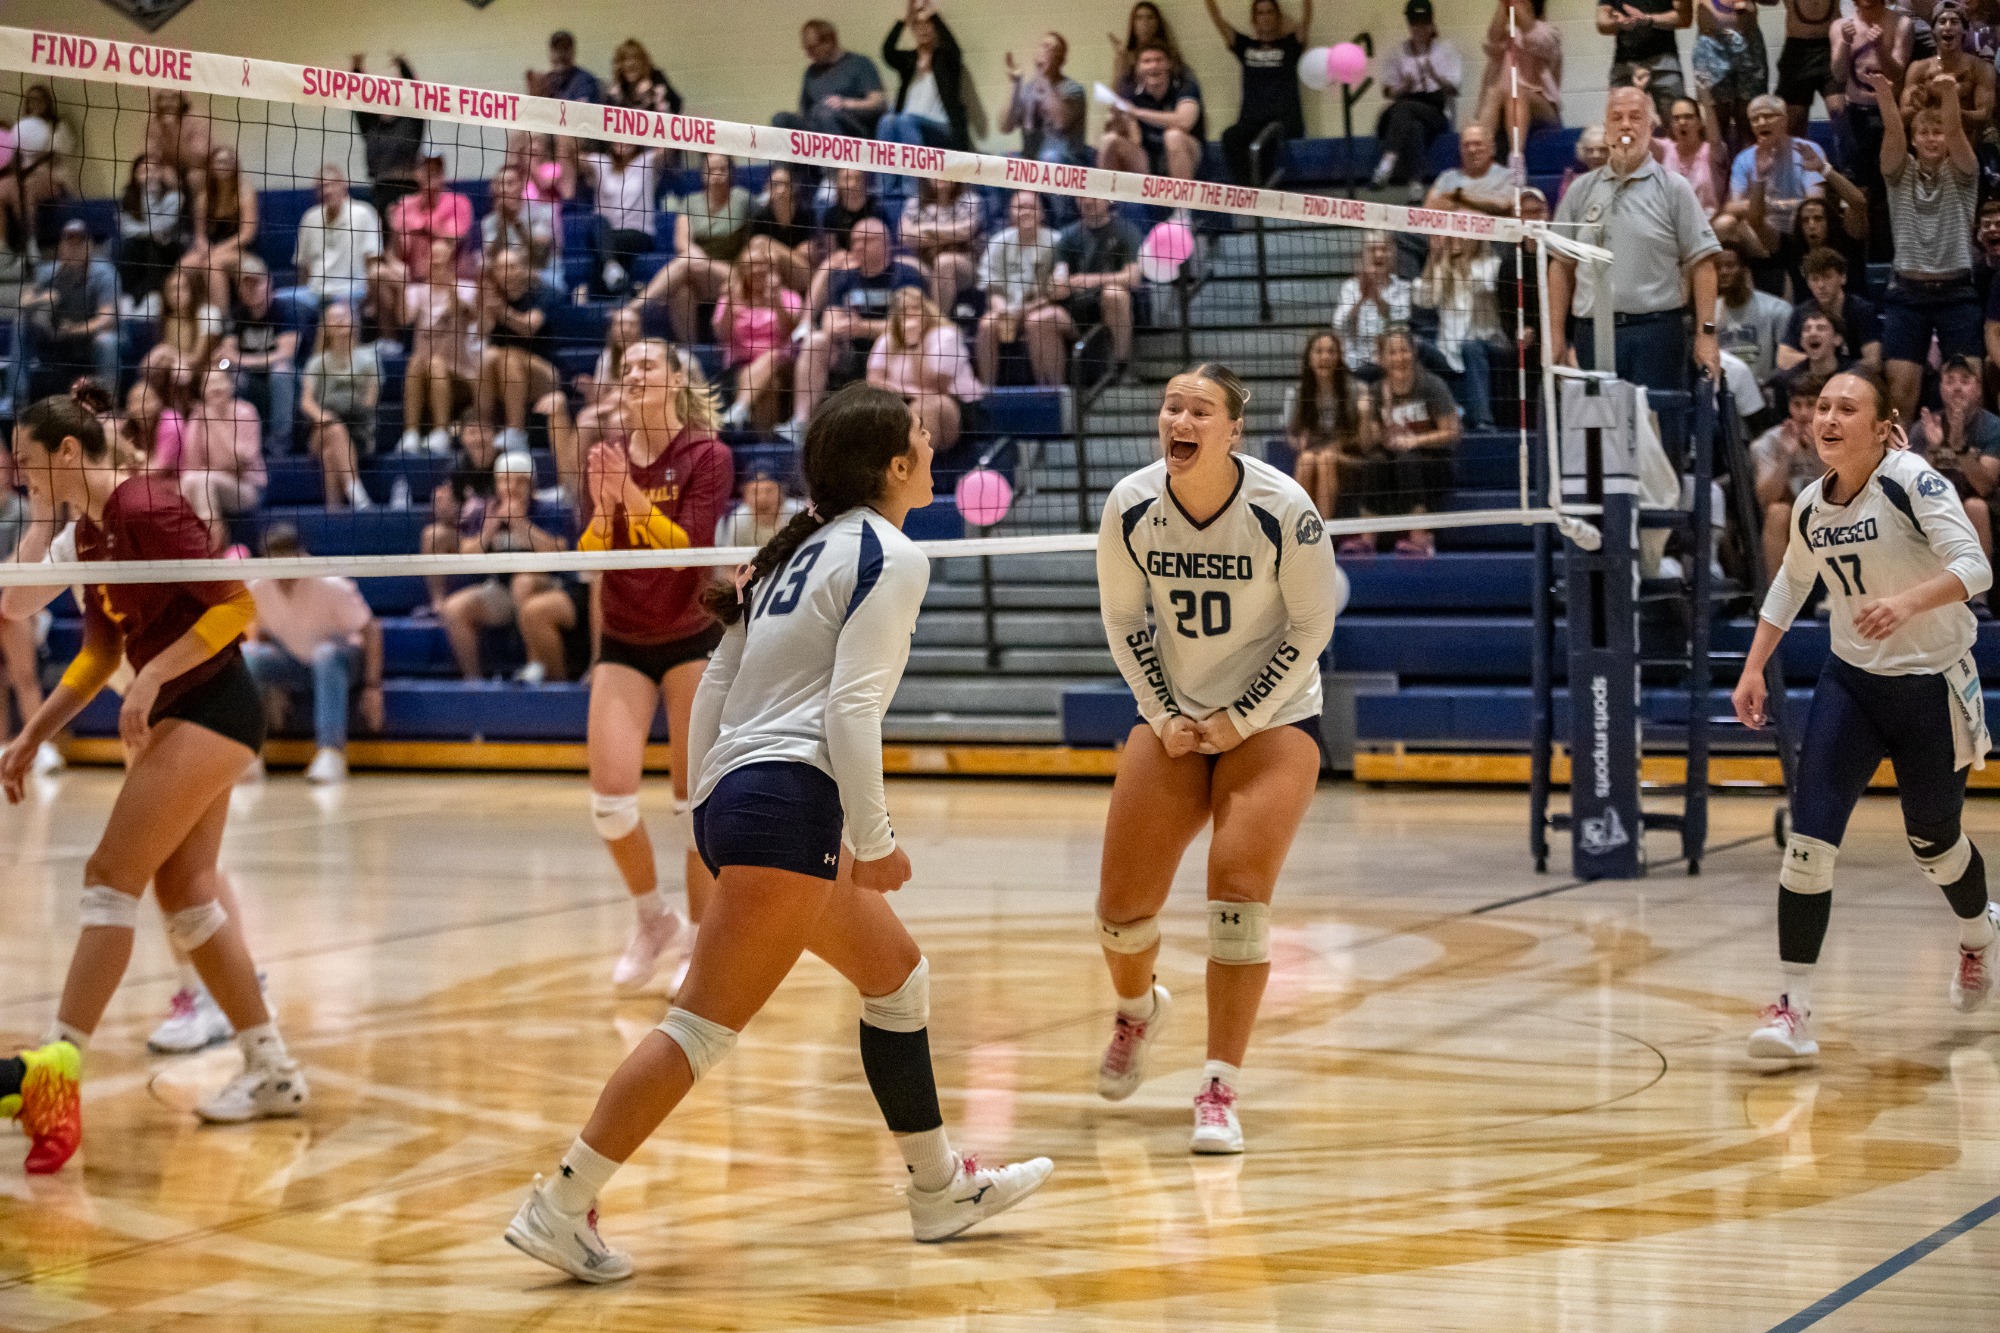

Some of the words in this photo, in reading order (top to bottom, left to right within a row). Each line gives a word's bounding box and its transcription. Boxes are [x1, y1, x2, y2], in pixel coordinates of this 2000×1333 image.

[31, 33, 97, 69] FIND
[103, 43, 121, 73] A
[129, 46, 193, 82] CURE
[302, 67, 403, 107] SUPPORT
[410, 81, 451, 113] THE
[459, 89, 520, 121] FIGHT
[603, 107, 649, 137] FIND
[653, 115, 666, 139] A
[671, 116, 716, 145] CURE
[790, 131, 862, 163] SUPPORT
[867, 142, 896, 167] THE
[902, 146, 946, 172] FIGHT
[1005, 159, 1039, 184] FIND
[1041, 165, 1051, 186] A
[1054, 166, 1088, 190] CURE
[1141, 177, 1197, 202] SUPPORT
[1200, 183, 1222, 206] THE
[1224, 187, 1260, 209] FIGHT
[1302, 196, 1329, 217] FIND
[1330, 200, 1337, 218] A
[1340, 200, 1366, 221] CURE
[1407, 207, 1448, 229] SUPPORT
[1451, 214, 1468, 232] THE
[1470, 215, 1496, 234] FIGHT
[753, 540, 828, 620] 13
[1147, 551, 1253, 580] GENESEO
[1825, 553, 1867, 597] 17
[1169, 589, 1232, 639] 20
[1591, 676, 1611, 730] sports
[1592, 731, 1612, 798] imports
